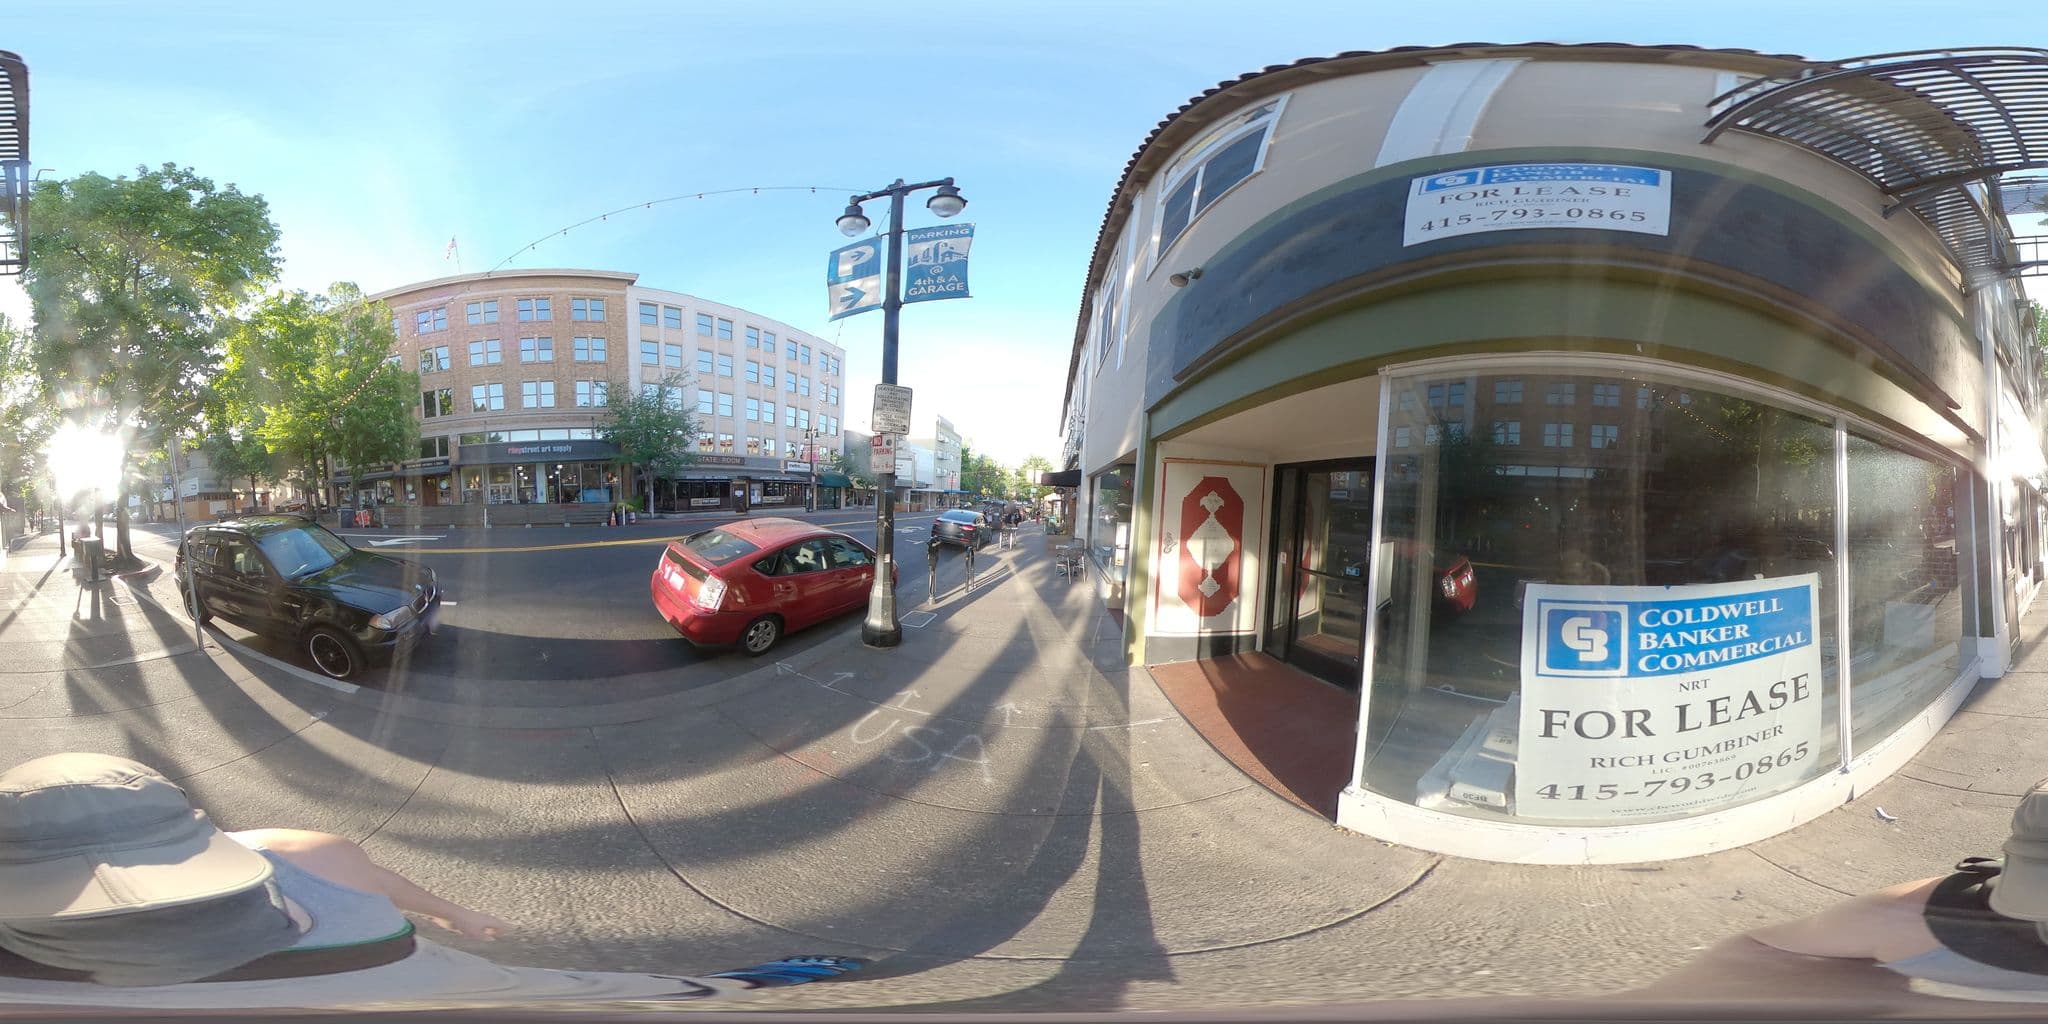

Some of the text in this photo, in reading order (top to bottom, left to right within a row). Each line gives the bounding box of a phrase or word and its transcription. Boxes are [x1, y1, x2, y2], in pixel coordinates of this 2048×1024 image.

[1439, 186, 1632, 204] FOR LEASE
[1420, 207, 1647, 232] 415-793-0865
[910, 228, 970, 241] PARKING
[838, 245, 875, 278] P
[908, 282, 965, 296] GARAGE
[914, 277, 934, 286] 4th
[948, 274, 959, 282] A
[1638, 597, 1783, 628] COLDWELL
[1638, 623, 1749, 651] BANKER
[1638, 631, 1806, 673] COMMERCIAL
[1679, 678, 1711, 692] NRT
[1538, 673, 1810, 741] FOR LEASE
[850, 709, 994, 783] USA
[1590, 724, 1784, 769] RICH GUMBINER
[1536, 740, 1810, 801] 415-793-0865
